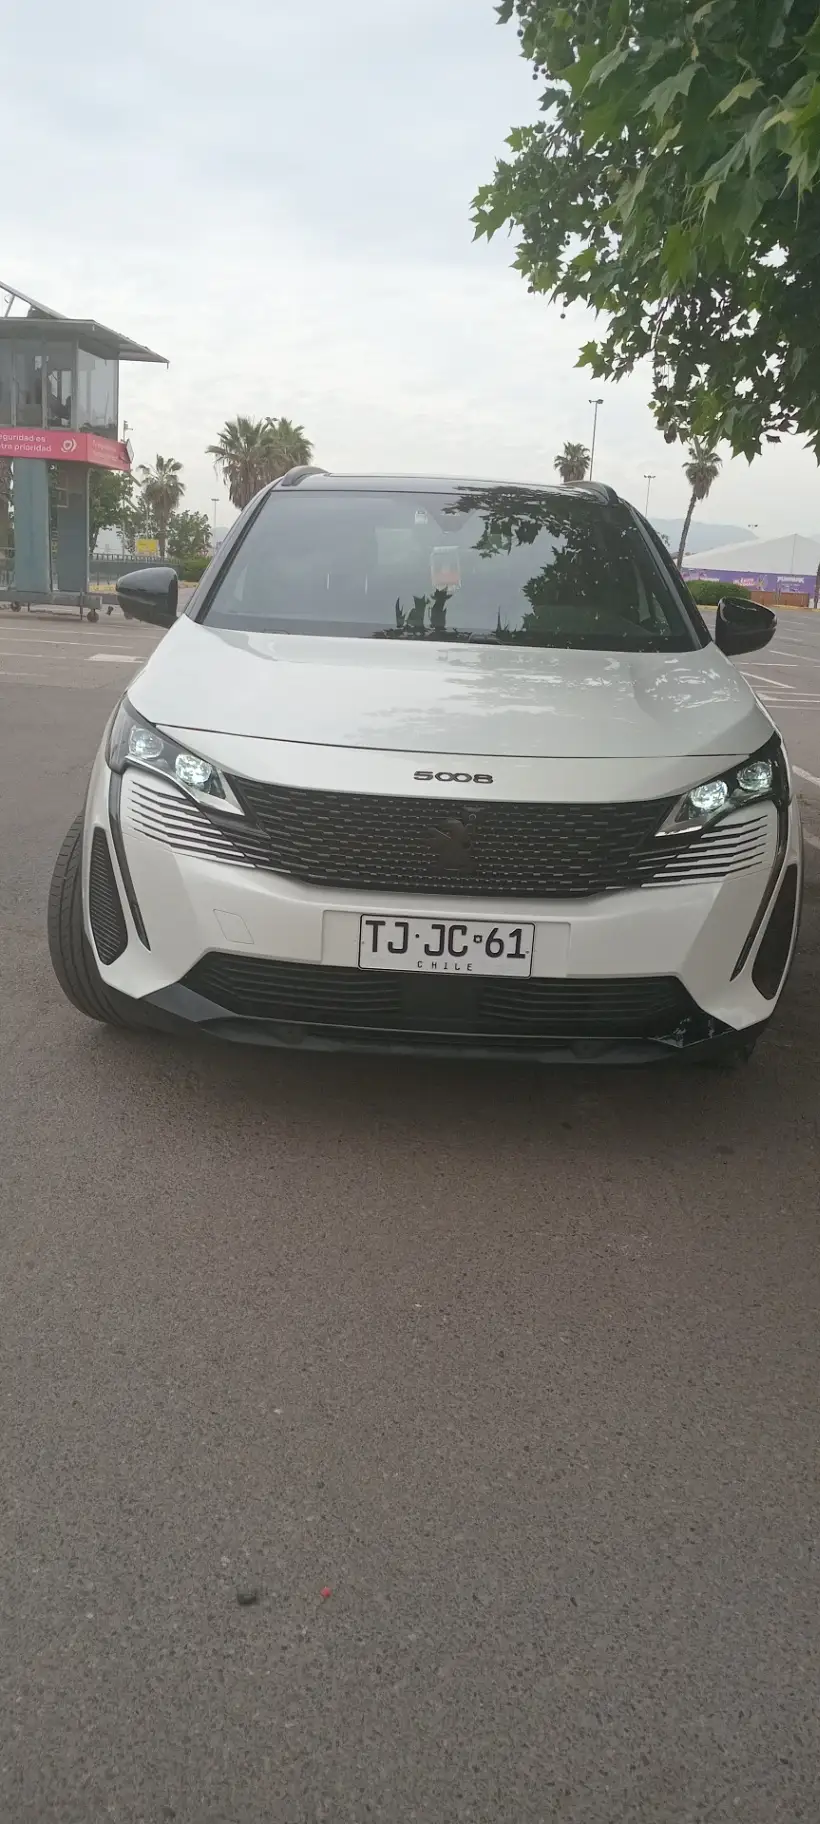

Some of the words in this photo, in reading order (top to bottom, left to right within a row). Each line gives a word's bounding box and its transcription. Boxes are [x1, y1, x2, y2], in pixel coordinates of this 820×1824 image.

[14, 443, 52, 452] prioridad
[413, 771, 494, 784] 5008
[417, 960, 473, 972] CHILE
